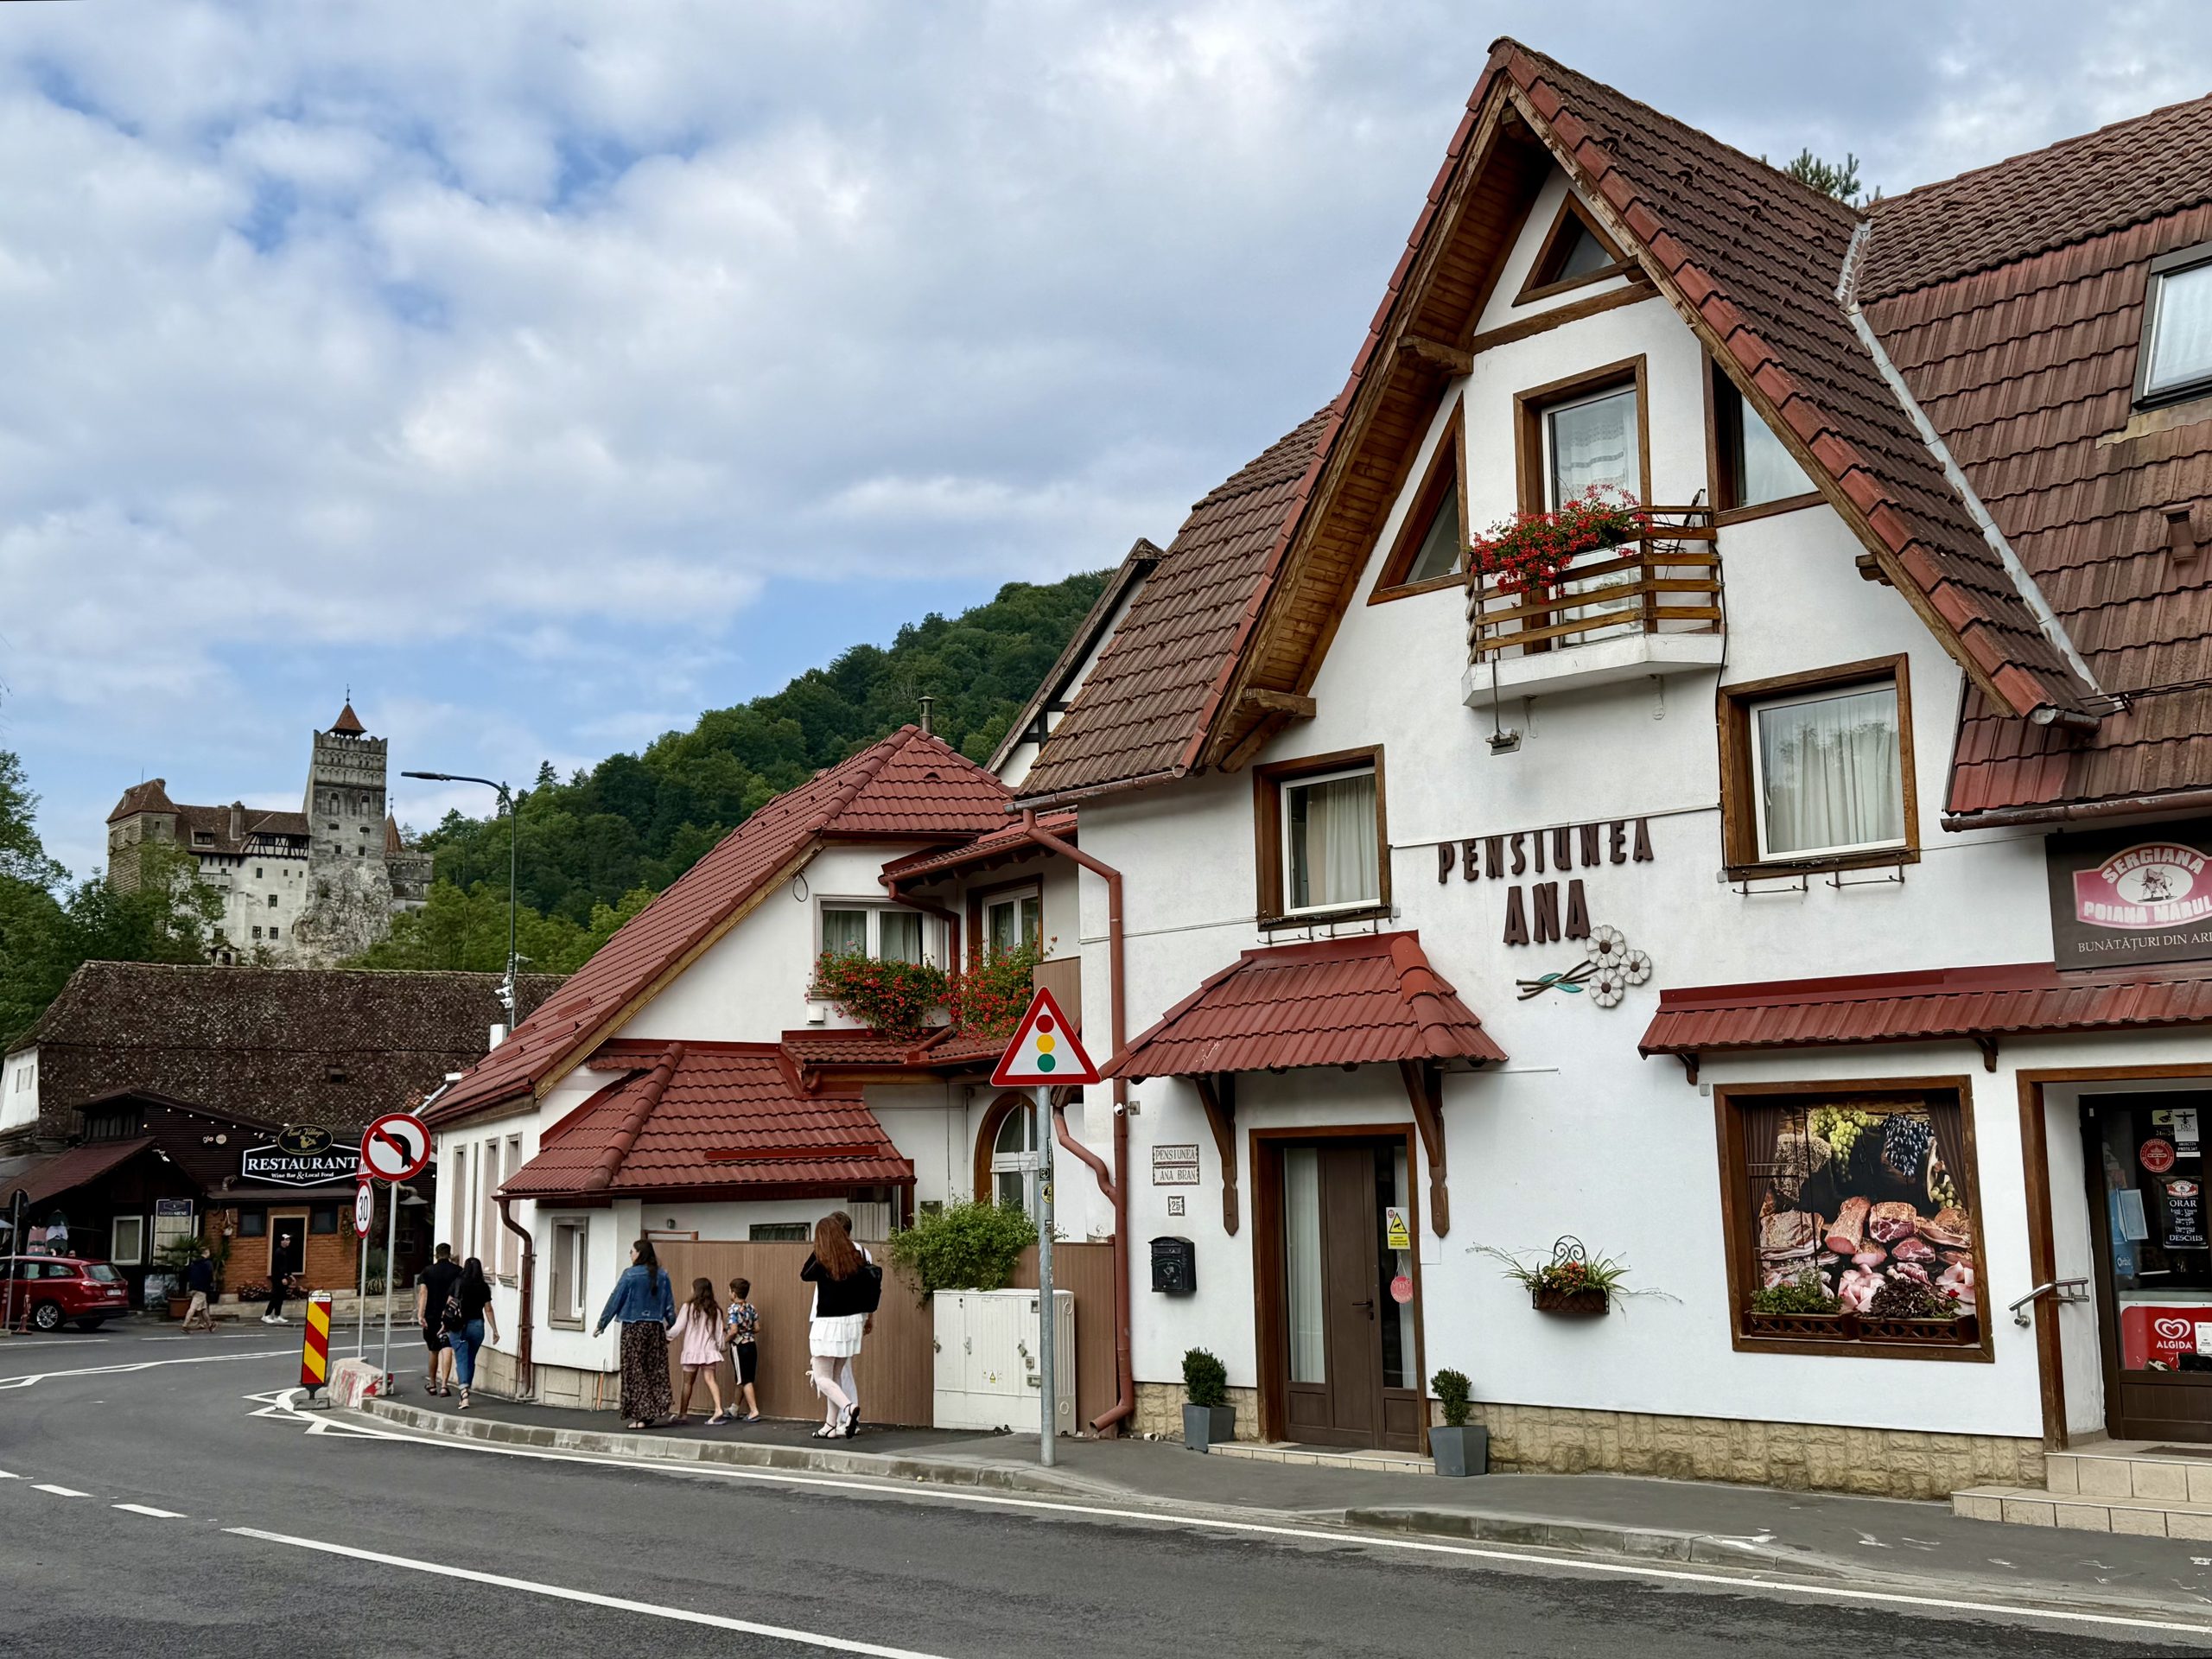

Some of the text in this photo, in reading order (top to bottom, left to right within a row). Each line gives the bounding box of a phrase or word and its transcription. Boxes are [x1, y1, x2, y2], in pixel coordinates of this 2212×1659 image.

[1438, 817, 1654, 884] PENSIUNEA
[2101, 848, 2205, 885] SERGIANA
[1503, 879, 1591, 946] ANA
[2083, 900, 2148, 924] POIANA
[2163, 933, 2187, 946] DIN
[1155, 1149, 1195, 1160] PENSIUNEA
[247, 1156, 359, 1171] RESTAURANT
[296, 1171, 305, 1179] &
[1160, 1169, 1196, 1180] ANA BRAN
[359, 1195, 369, 1222] 30
[1171, 1200, 1181, 1211] 25
[2156, 1340, 2192, 1349] ALGIDA
